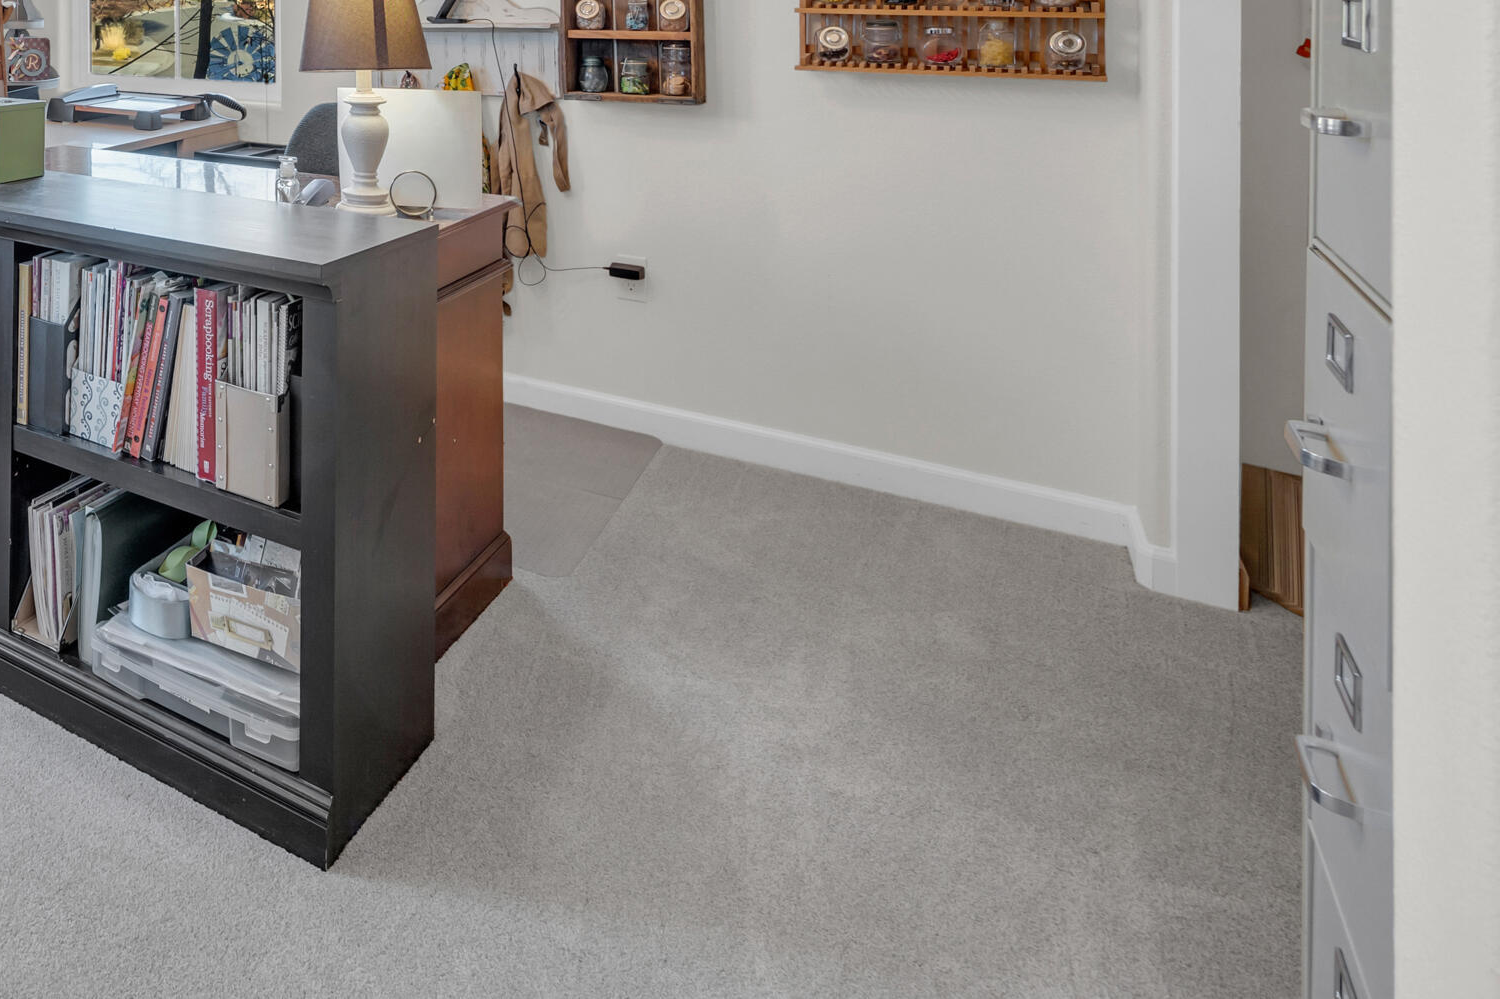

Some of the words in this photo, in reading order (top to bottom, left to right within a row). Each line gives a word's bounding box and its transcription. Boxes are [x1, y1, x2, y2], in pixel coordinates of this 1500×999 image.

[139, 323, 153, 375] SCRAPBOOKING
[204, 299, 214, 381] Scrapbooking
[133, 375, 145, 405] EVERYDAY
